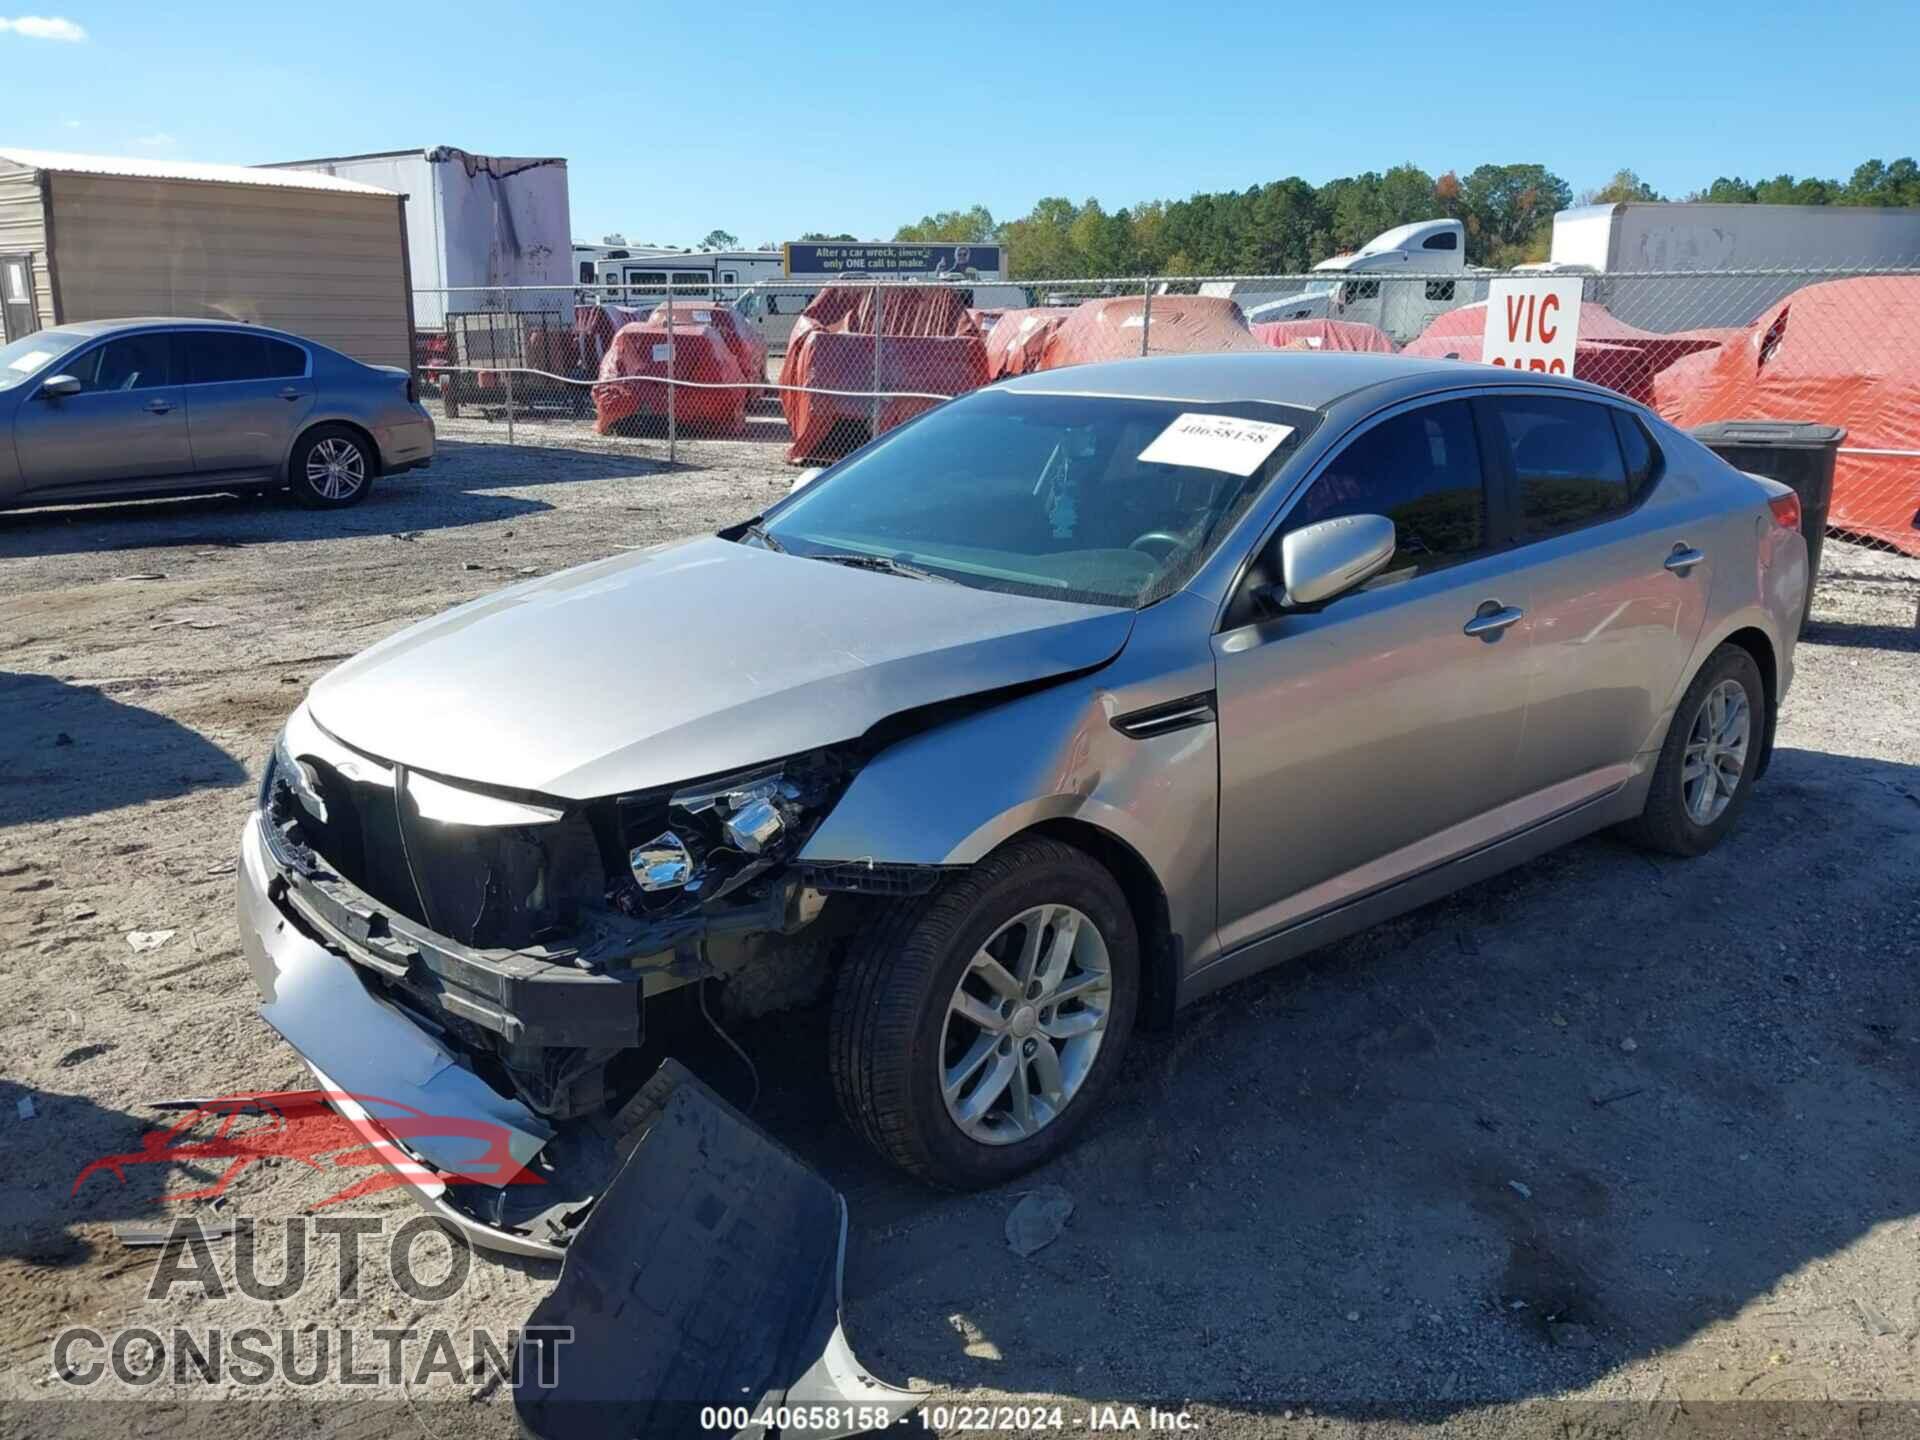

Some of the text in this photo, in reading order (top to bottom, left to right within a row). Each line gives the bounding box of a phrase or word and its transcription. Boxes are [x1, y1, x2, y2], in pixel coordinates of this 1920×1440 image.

[816, 247, 839, 257] After
[866, 247, 897, 258] wreck,
[823, 258, 926, 269] only ONE call to make.
[1506, 293, 1560, 344] VIC
